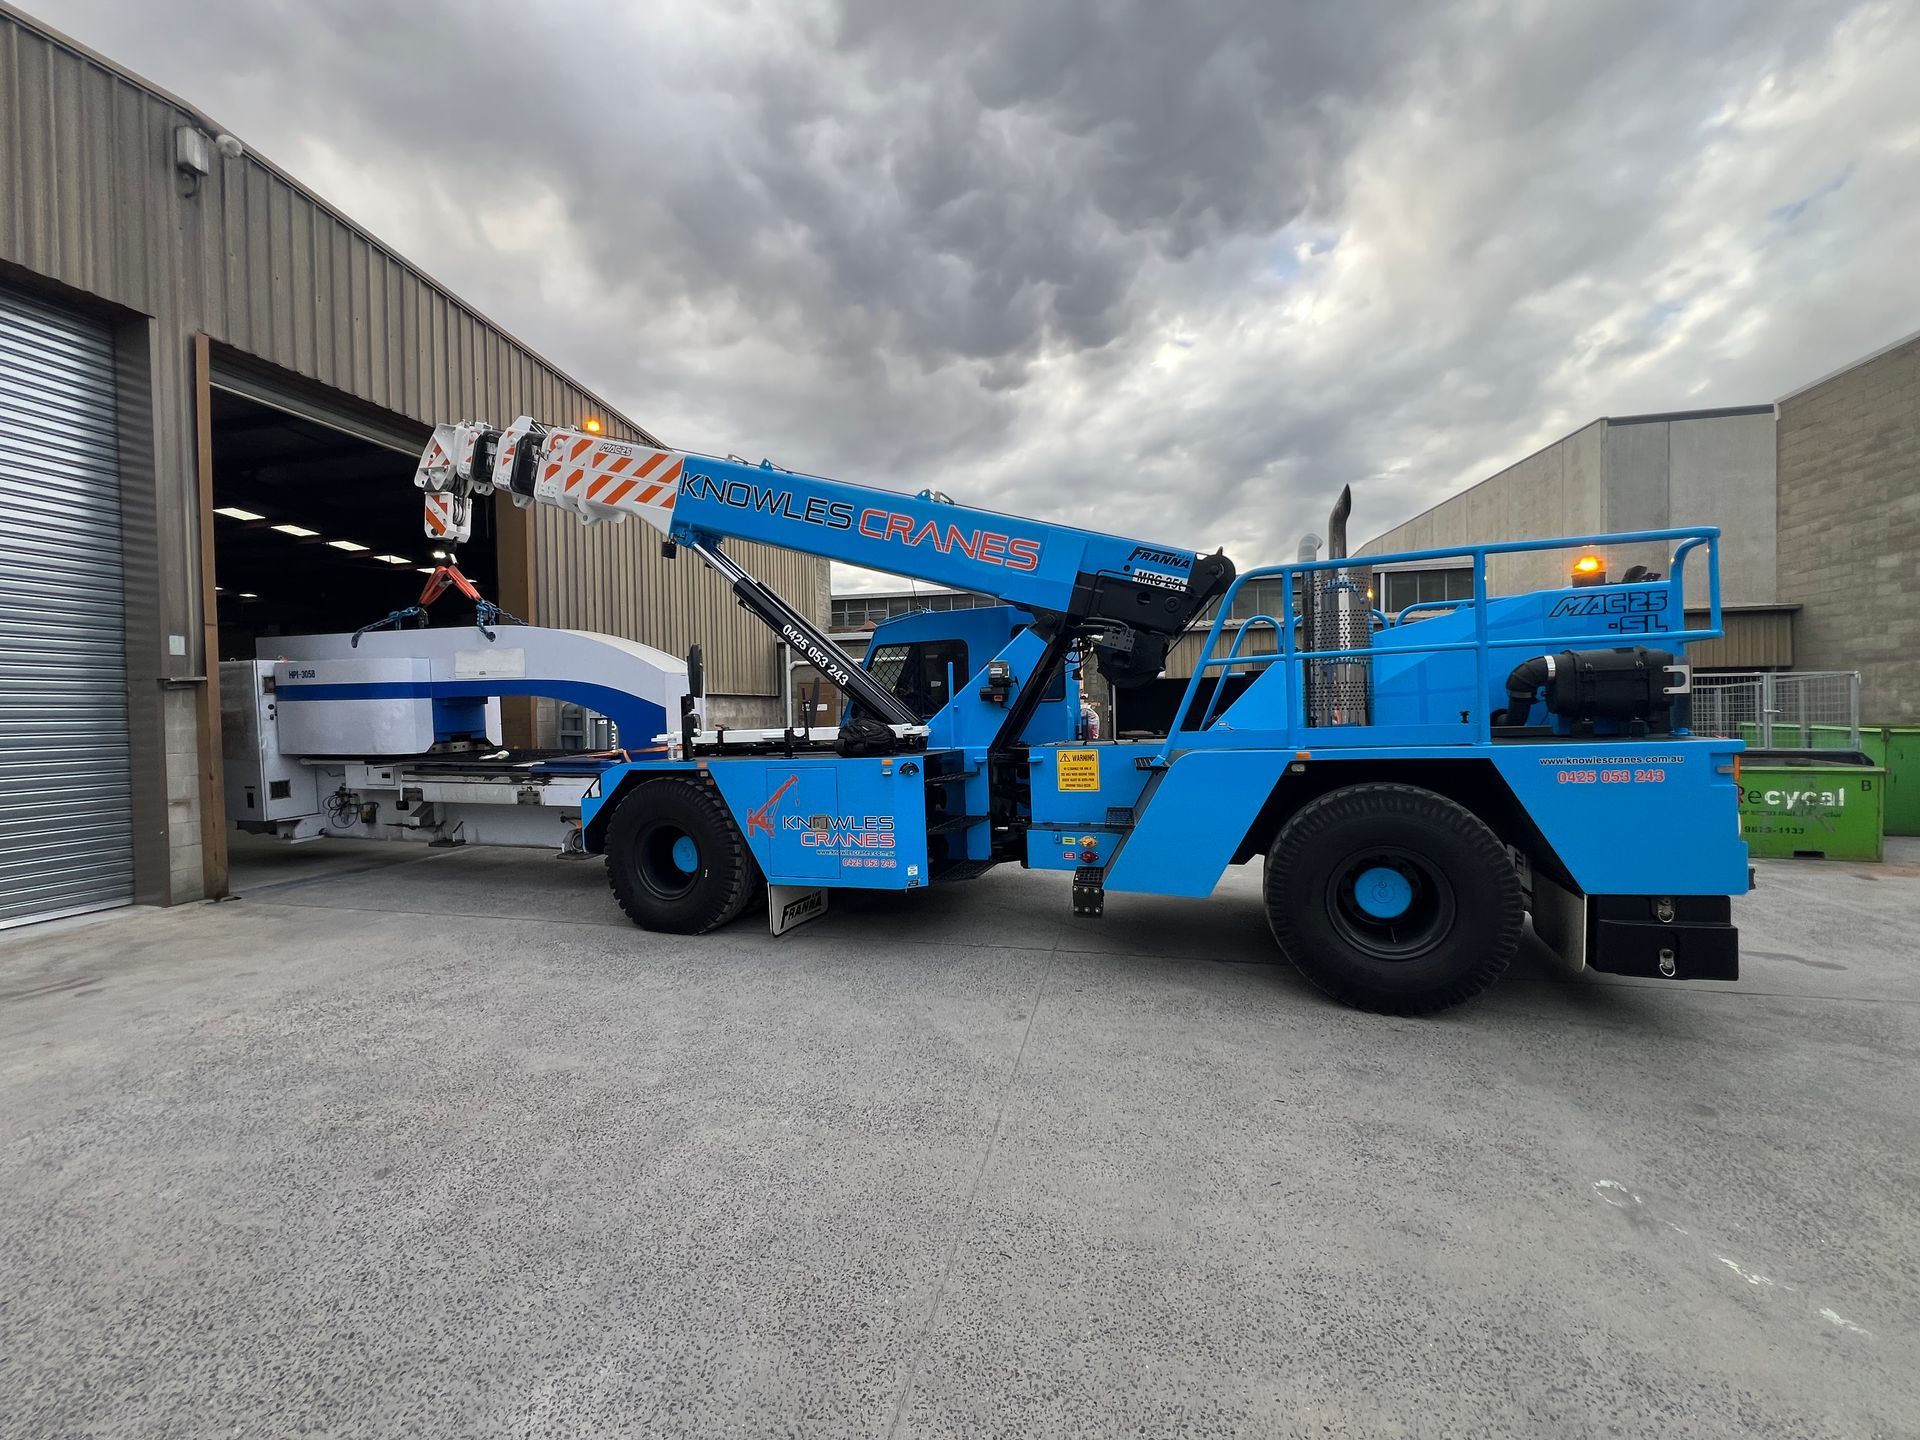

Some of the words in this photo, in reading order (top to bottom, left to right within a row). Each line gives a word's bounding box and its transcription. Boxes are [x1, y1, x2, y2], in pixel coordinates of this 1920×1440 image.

[680, 471, 853, 530] KNOWLES
[858, 508, 1041, 571] CRANES
[1127, 546, 1191, 569] FRANNA
[782, 624, 809, 650] 0425
[807, 646, 829, 668] 053
[827, 664, 849, 686] 243
[1071, 754, 1095, 762] WARNING
[1539, 755, 1684, 765] www.knowlescranes.com.au
[1558, 771, 1596, 784] 0425
[1601, 770, 1630, 783] 053
[1634, 769, 1665, 782] 243
[1861, 780, 1872, 791] B
[782, 815, 895, 831] KNOWLES
[800, 832, 896, 848] CRANES
[880, 859, 897, 868] 243
